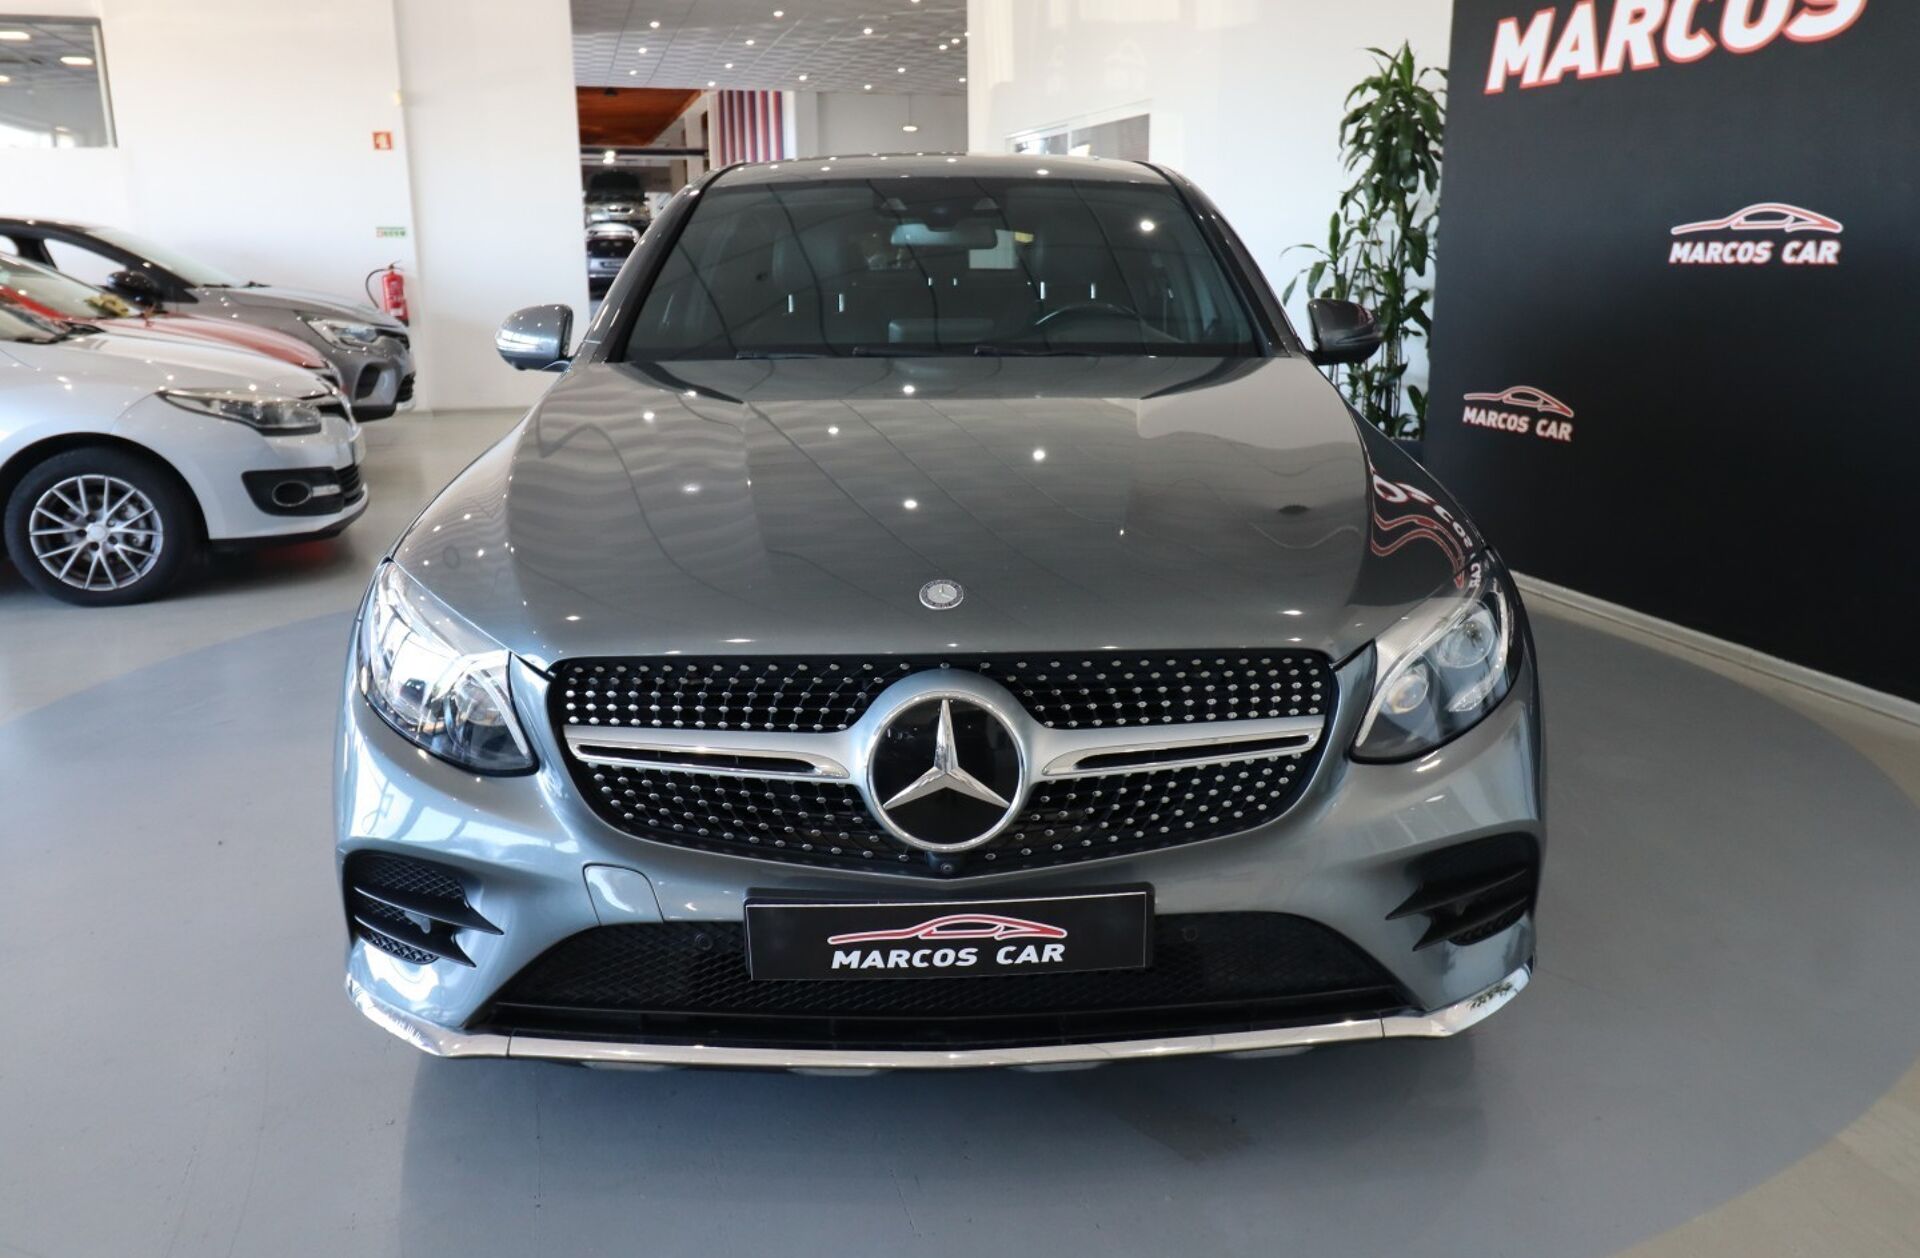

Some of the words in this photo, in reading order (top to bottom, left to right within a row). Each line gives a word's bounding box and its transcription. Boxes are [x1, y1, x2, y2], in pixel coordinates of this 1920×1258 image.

[1669, 241, 1774, 264] MARCOS
[1781, 239, 1841, 264] CAR
[1462, 405, 1530, 433] MARCOS
[1535, 419, 1573, 442] CAR
[831, 948, 978, 969] MARCOS
[996, 944, 1066, 965] CAR
